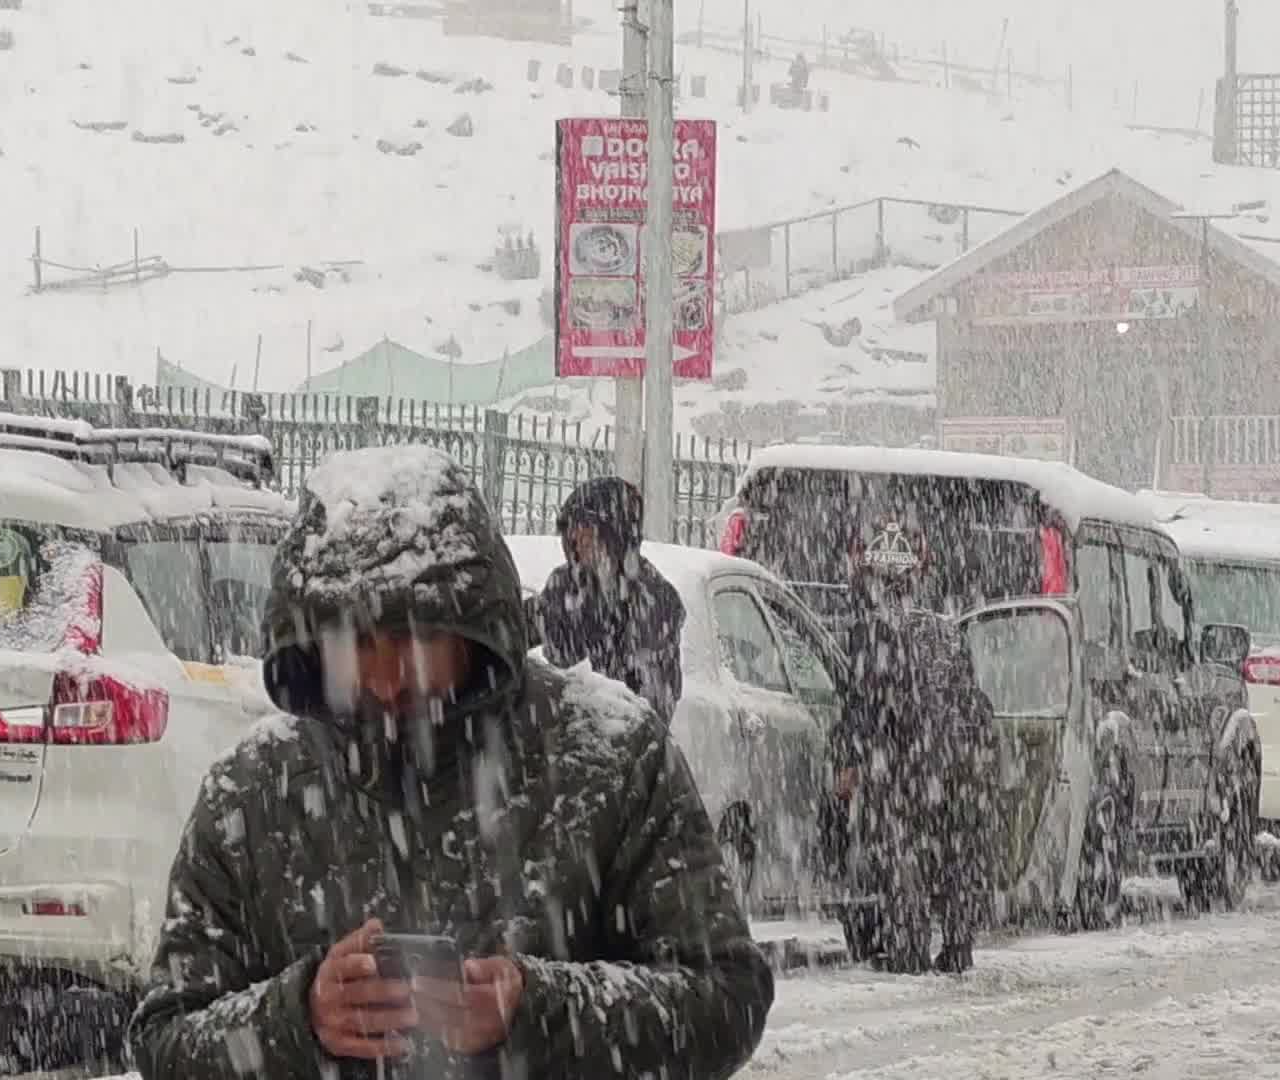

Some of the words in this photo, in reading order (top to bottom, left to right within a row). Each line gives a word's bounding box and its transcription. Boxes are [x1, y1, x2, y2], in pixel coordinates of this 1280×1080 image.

[607, 138, 699, 160] DOA
[591, 161, 690, 181] VAISO
[576, 183, 703, 203] BHOJNYA
